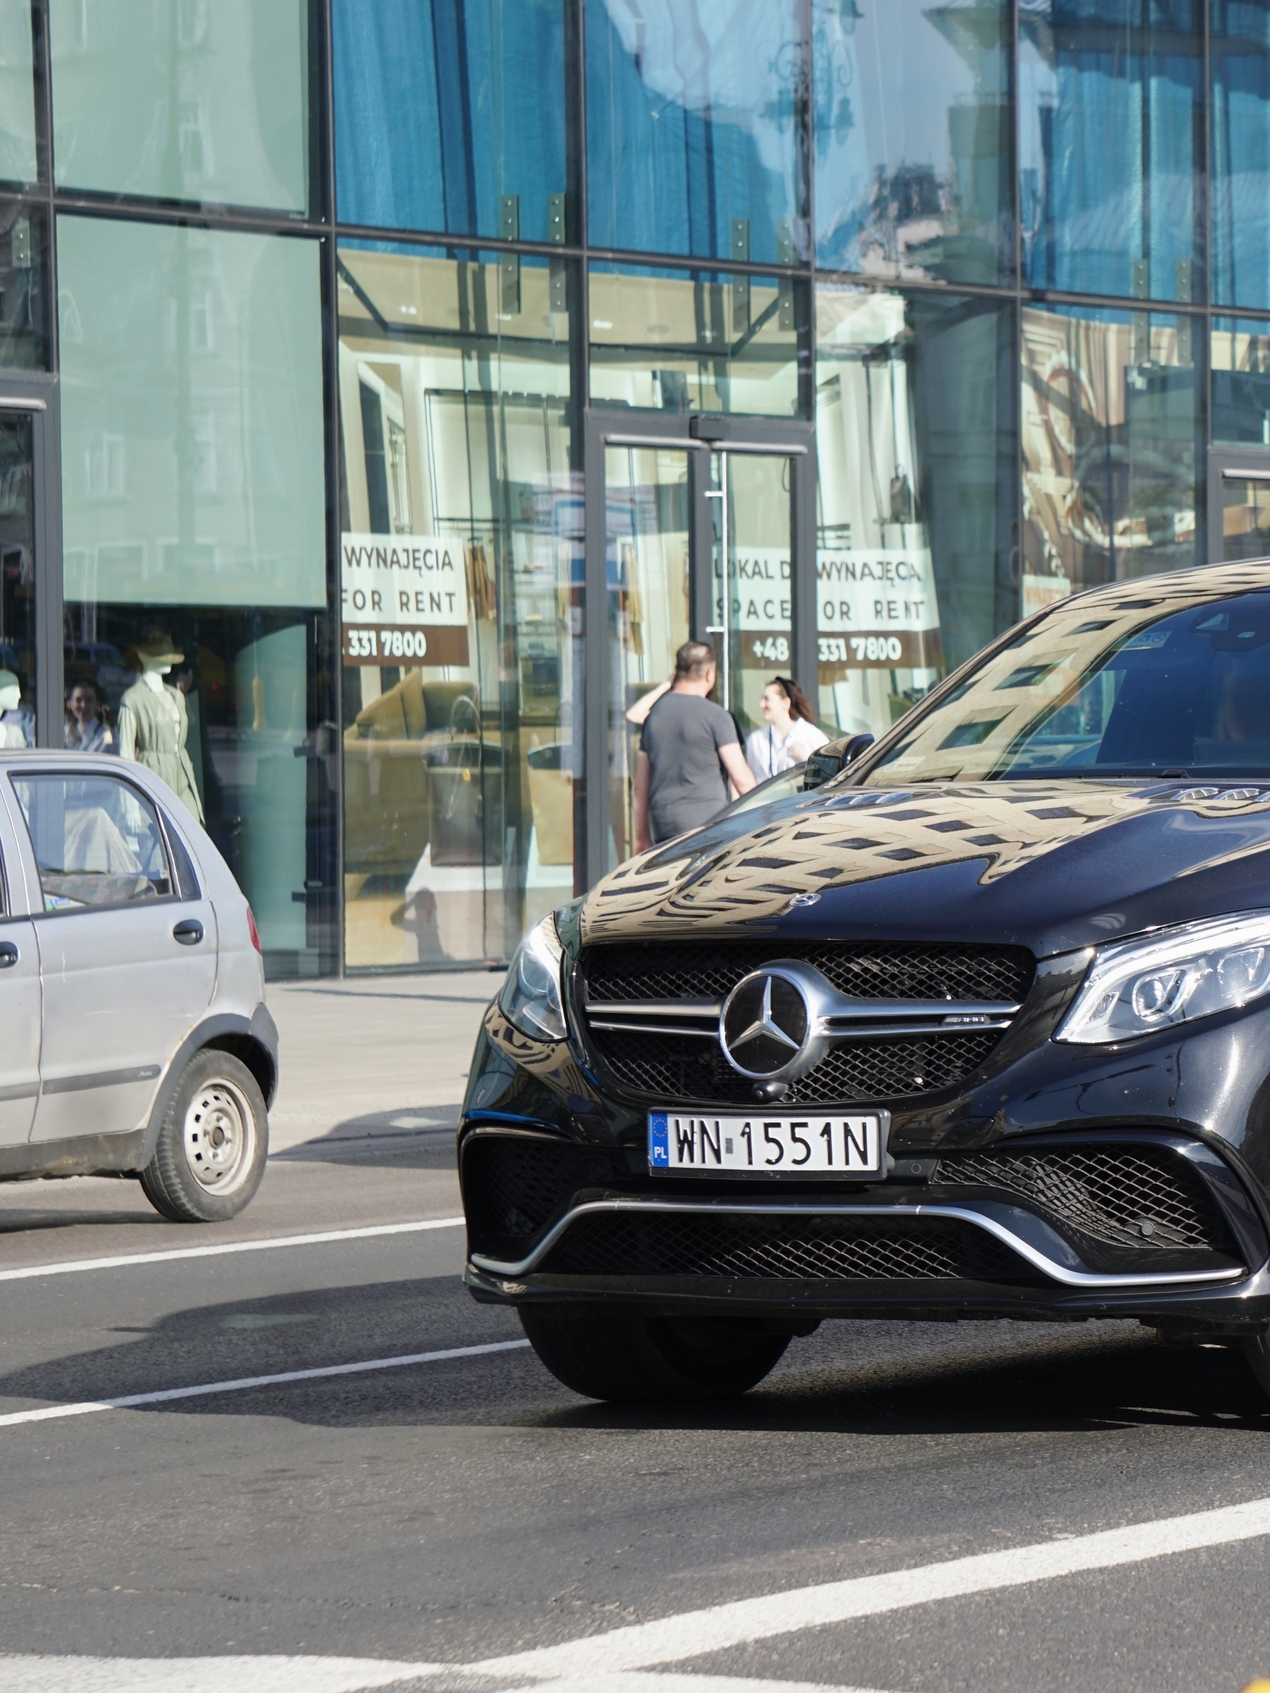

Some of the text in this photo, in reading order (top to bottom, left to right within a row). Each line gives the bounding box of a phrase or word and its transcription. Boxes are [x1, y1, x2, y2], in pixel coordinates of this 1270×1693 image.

[343, 546, 454, 577] WYNAJĘCIA
[398, 590, 456, 614] RENT
[716, 598, 792, 621] SPACE
[873, 600, 925, 621] RENT
[348, 629, 427, 658] 331 7800
[753, 636, 902, 662] +48 331 7800
[654, 1118, 869, 1167] PL WN 1551N
